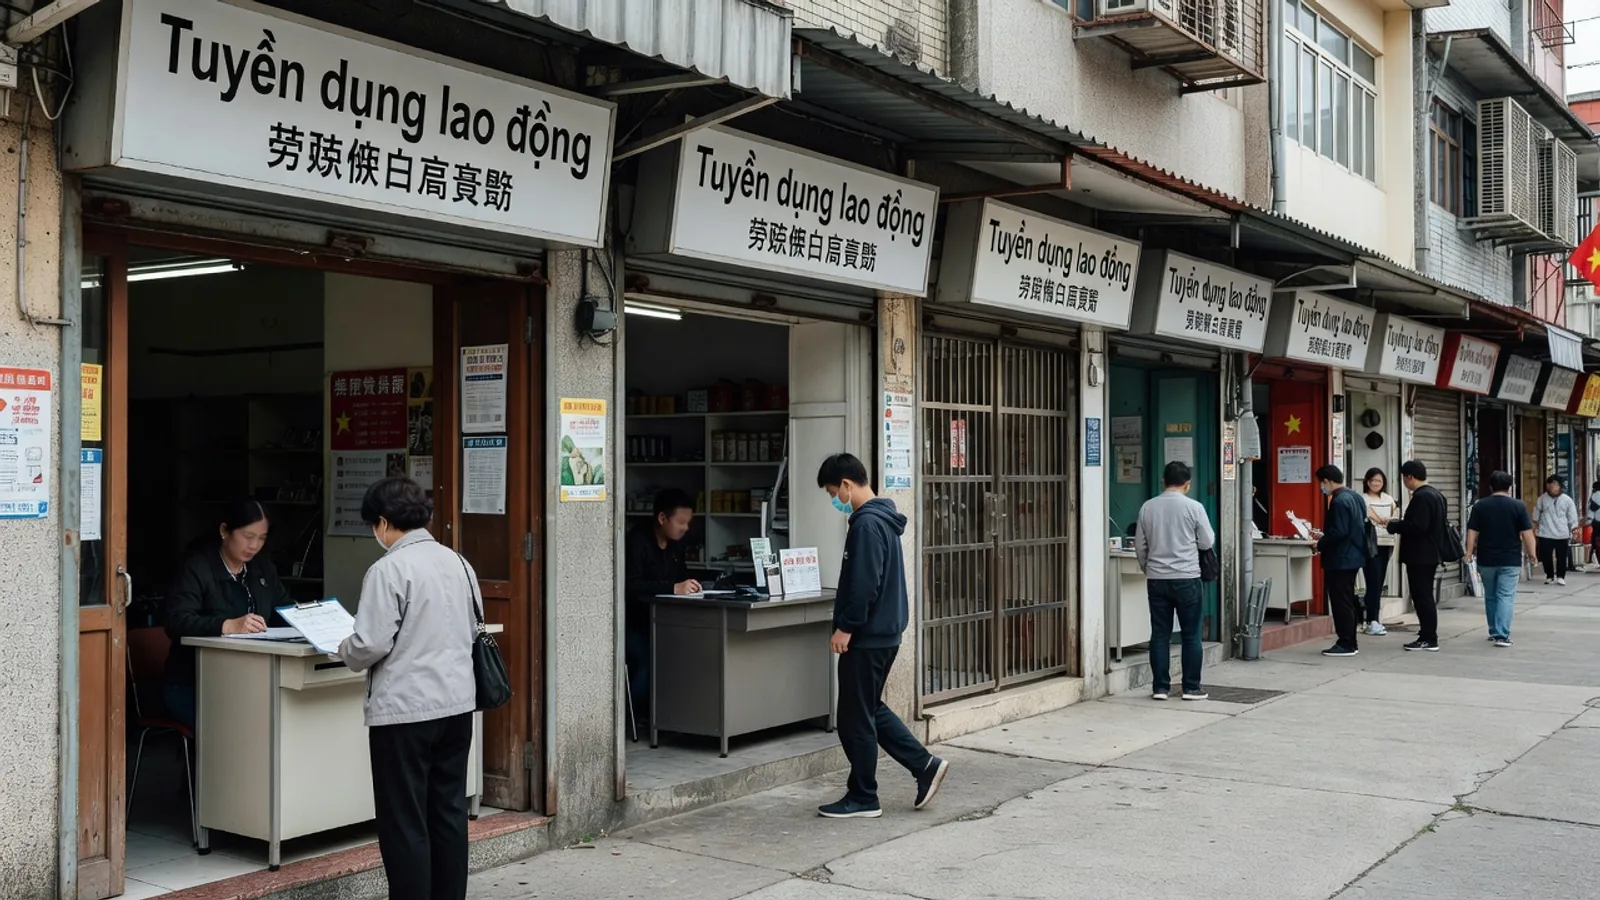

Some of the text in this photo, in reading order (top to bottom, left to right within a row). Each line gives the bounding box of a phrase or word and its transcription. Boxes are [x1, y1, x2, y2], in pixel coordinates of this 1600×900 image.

[160, 13, 304, 102] Tuyền
[320, 59, 426, 143] dụng
[439, 84, 495, 145] lao
[777, 168, 833, 226] dụng
[840, 182, 870, 225] lao
[1038, 233, 1073, 278] dụng
[1076, 242, 1096, 275] lao
